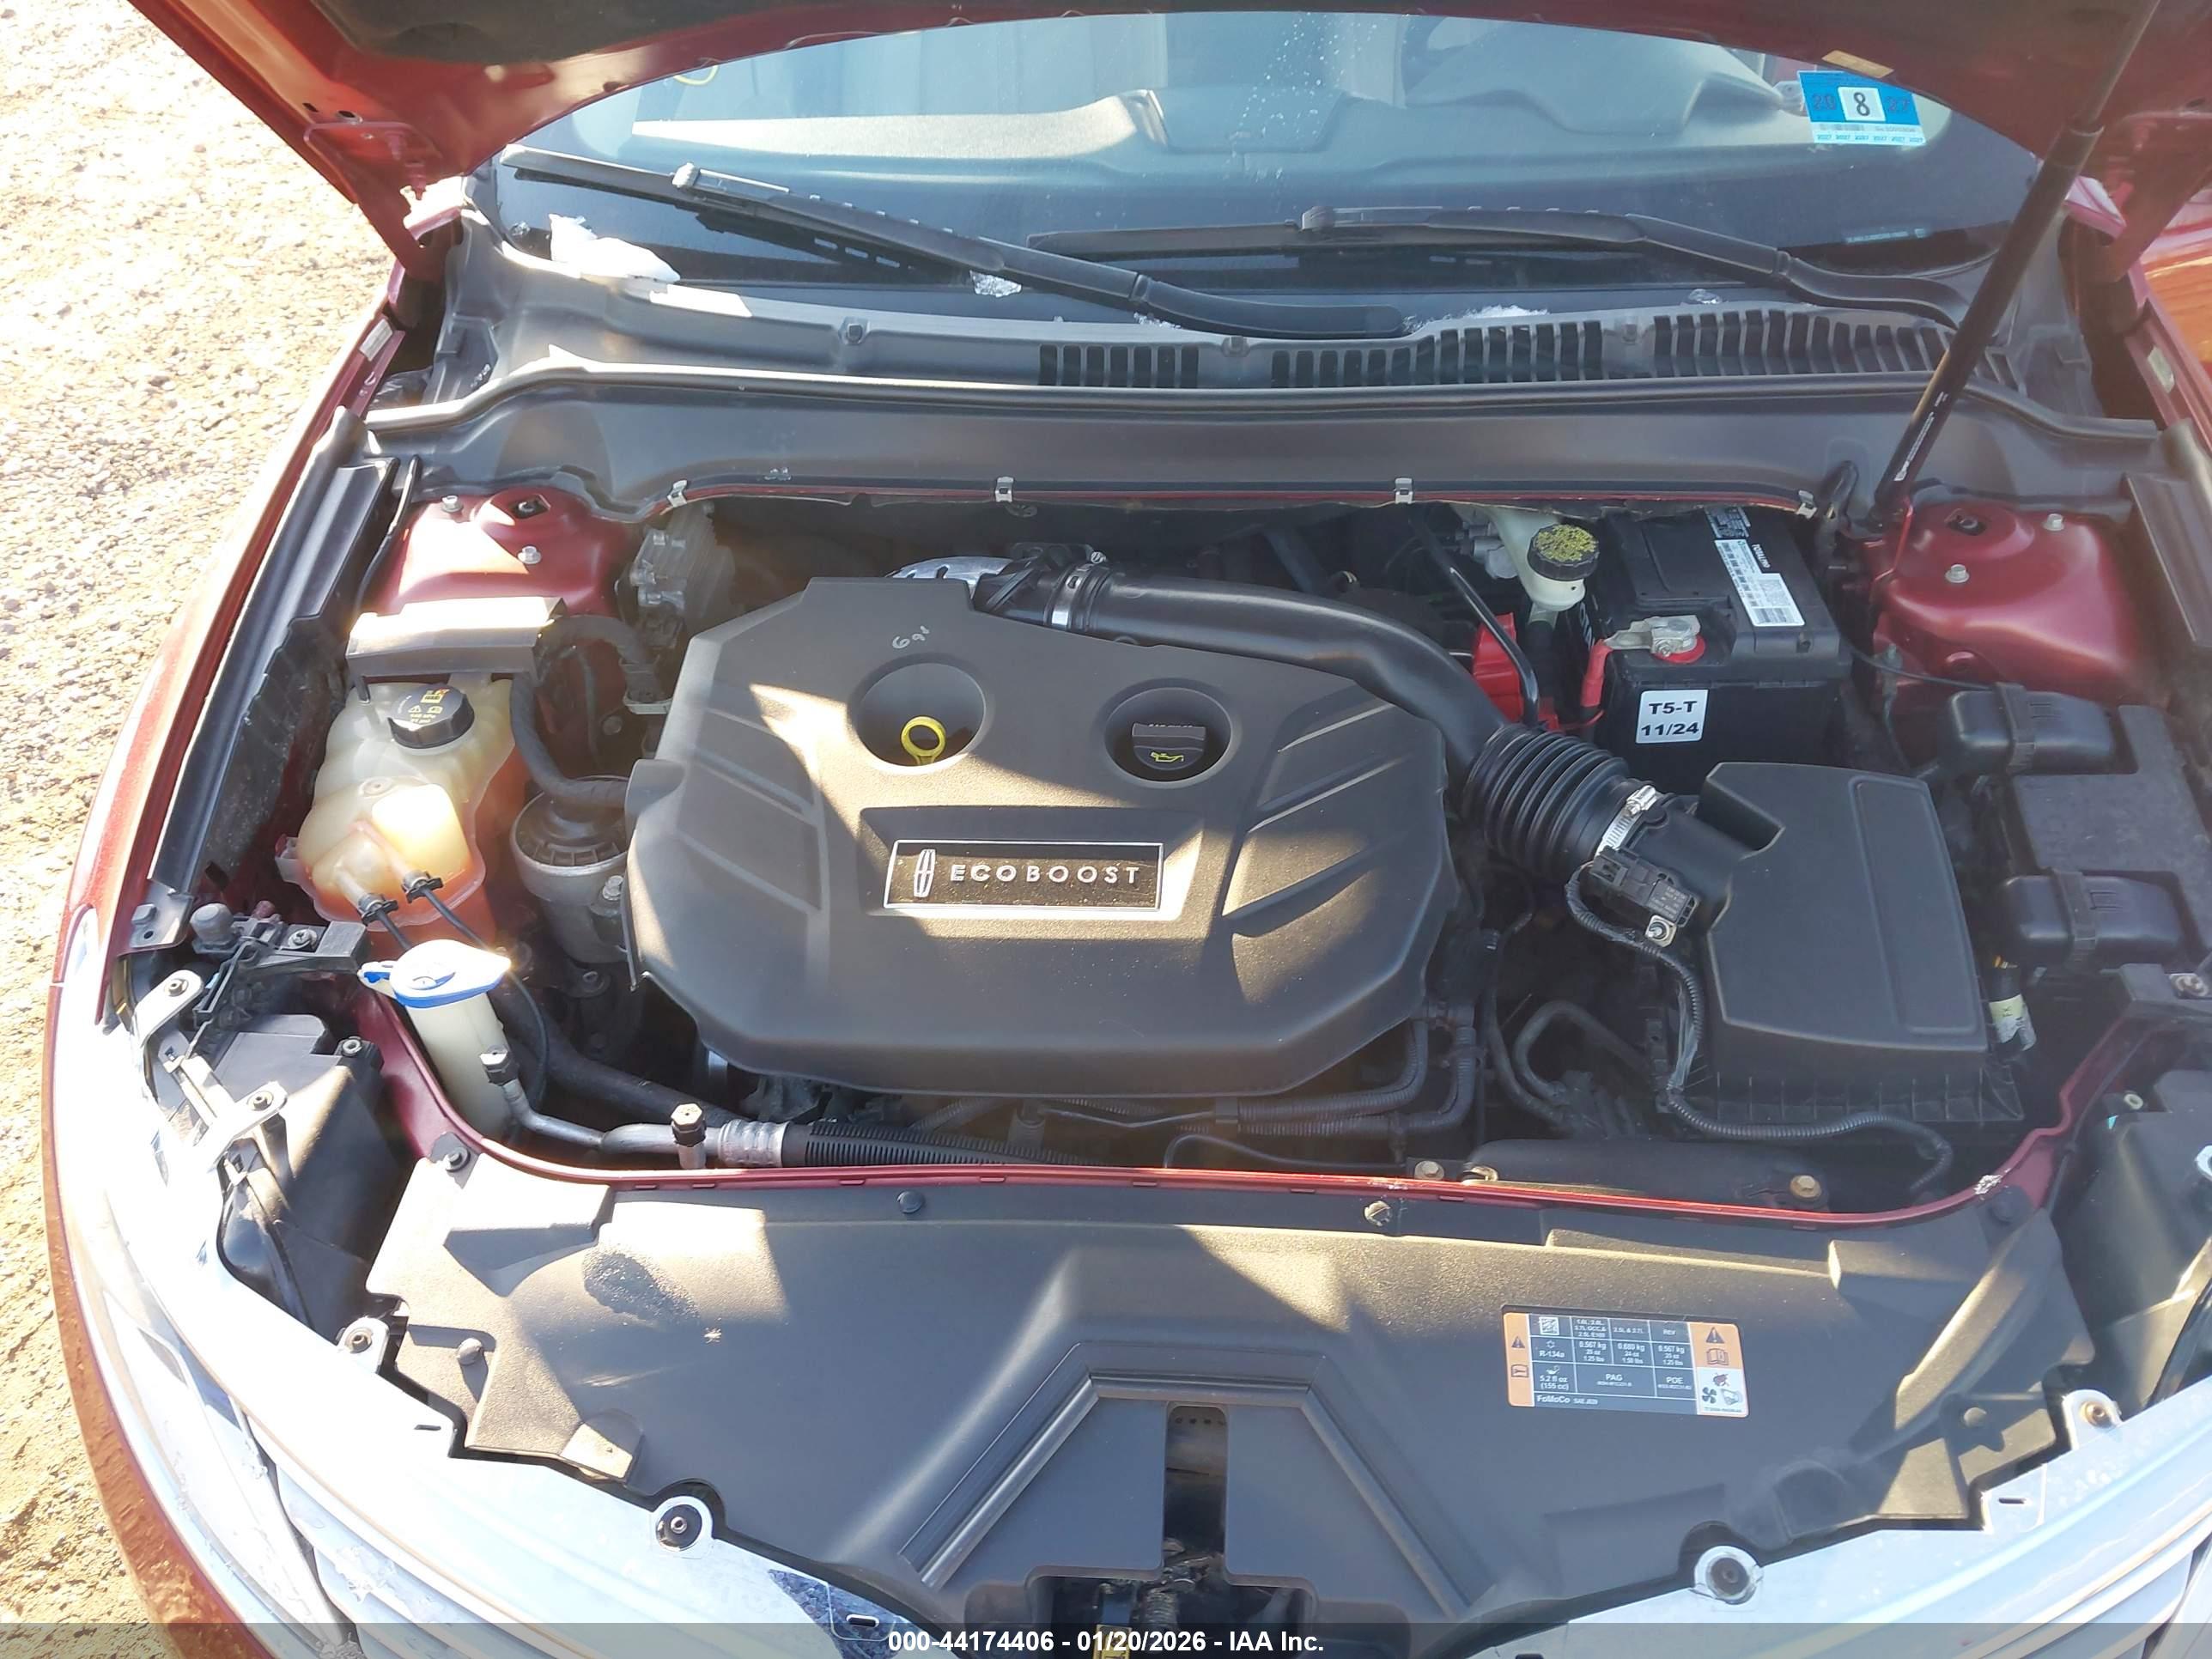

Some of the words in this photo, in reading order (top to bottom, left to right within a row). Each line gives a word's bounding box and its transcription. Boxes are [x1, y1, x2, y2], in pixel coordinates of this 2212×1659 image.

[1812, 93, 1837, 111] 20
[1853, 92, 1870, 117] 8
[1648, 700, 1698, 715] T5-T
[1640, 721, 1699, 737] 11/24
[950, 864, 1139, 884] ECOBOOST
[1536, 1395, 1571, 1403] FoMoCo
